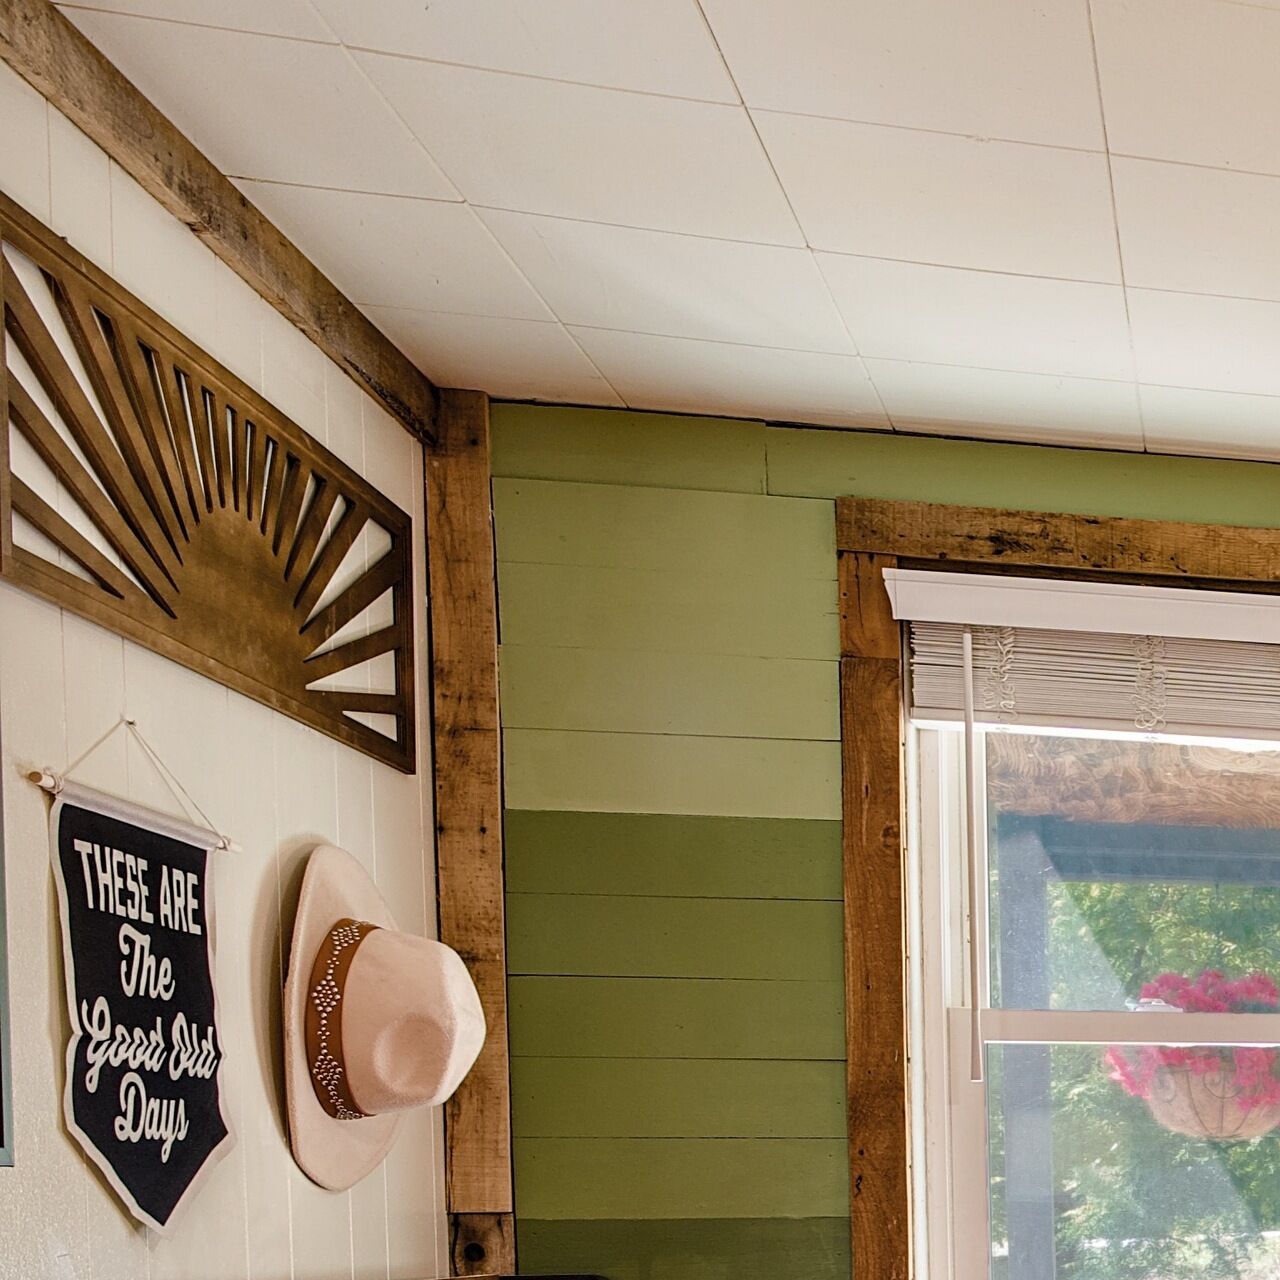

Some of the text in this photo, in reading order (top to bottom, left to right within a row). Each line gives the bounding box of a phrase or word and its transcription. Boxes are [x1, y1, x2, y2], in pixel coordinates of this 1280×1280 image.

[74, 839, 202, 935] THESE ARE
[119, 923, 176, 1001] The
[82, 996, 217, 1093] Good Old
[114, 1072, 190, 1164] Days
